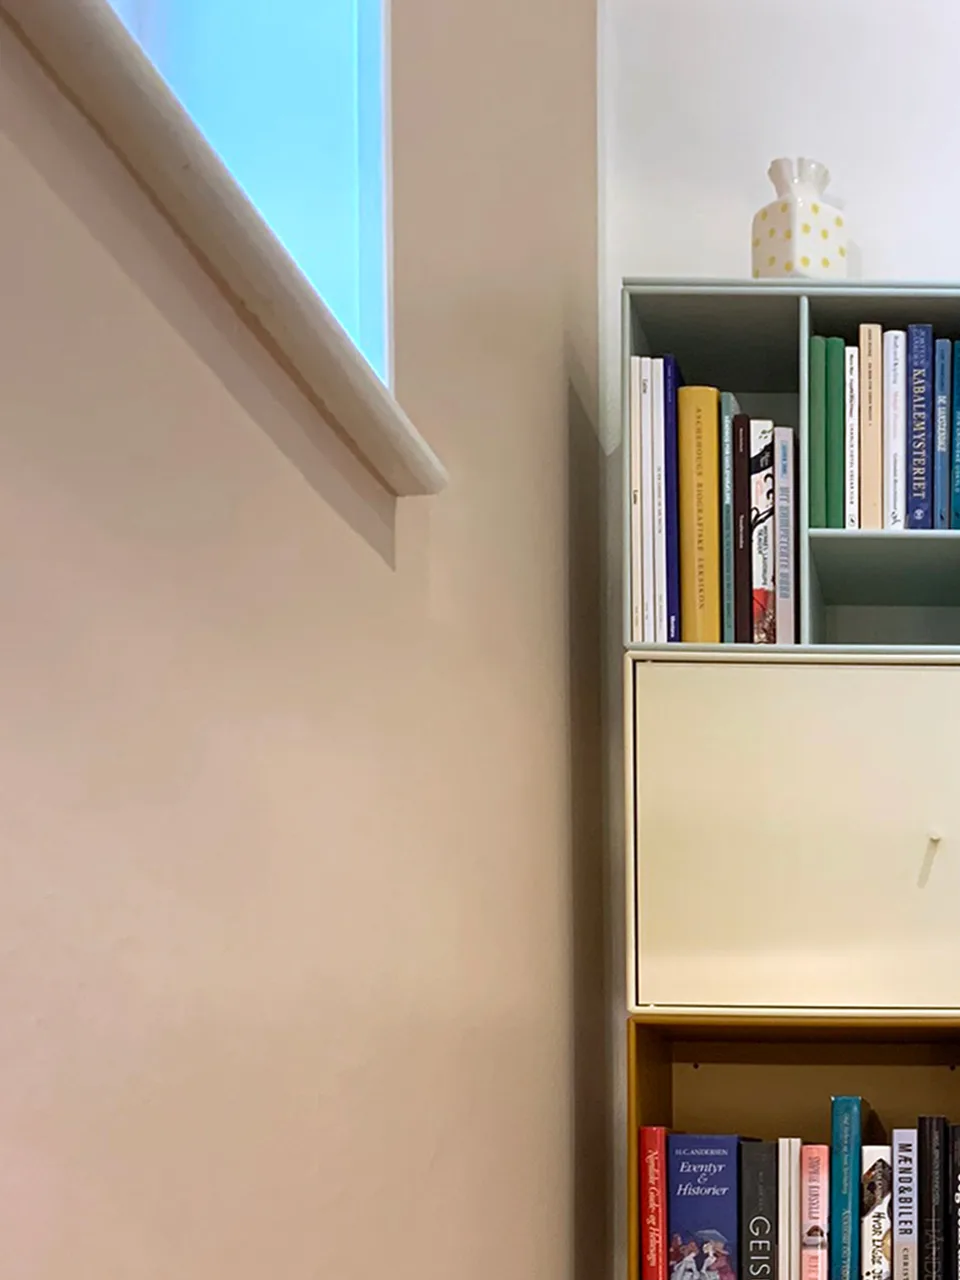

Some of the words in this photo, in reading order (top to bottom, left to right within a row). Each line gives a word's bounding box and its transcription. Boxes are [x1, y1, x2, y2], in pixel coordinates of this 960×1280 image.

[695, 407, 703, 477] ASCHEHOUGS
[912, 369, 926, 499] KABALEMYSTERIET
[696, 482, 704, 552] BIOGRAFISKE
[676, 1182, 729, 1196] Historier
[679, 1161, 726, 1176] Eventyr
